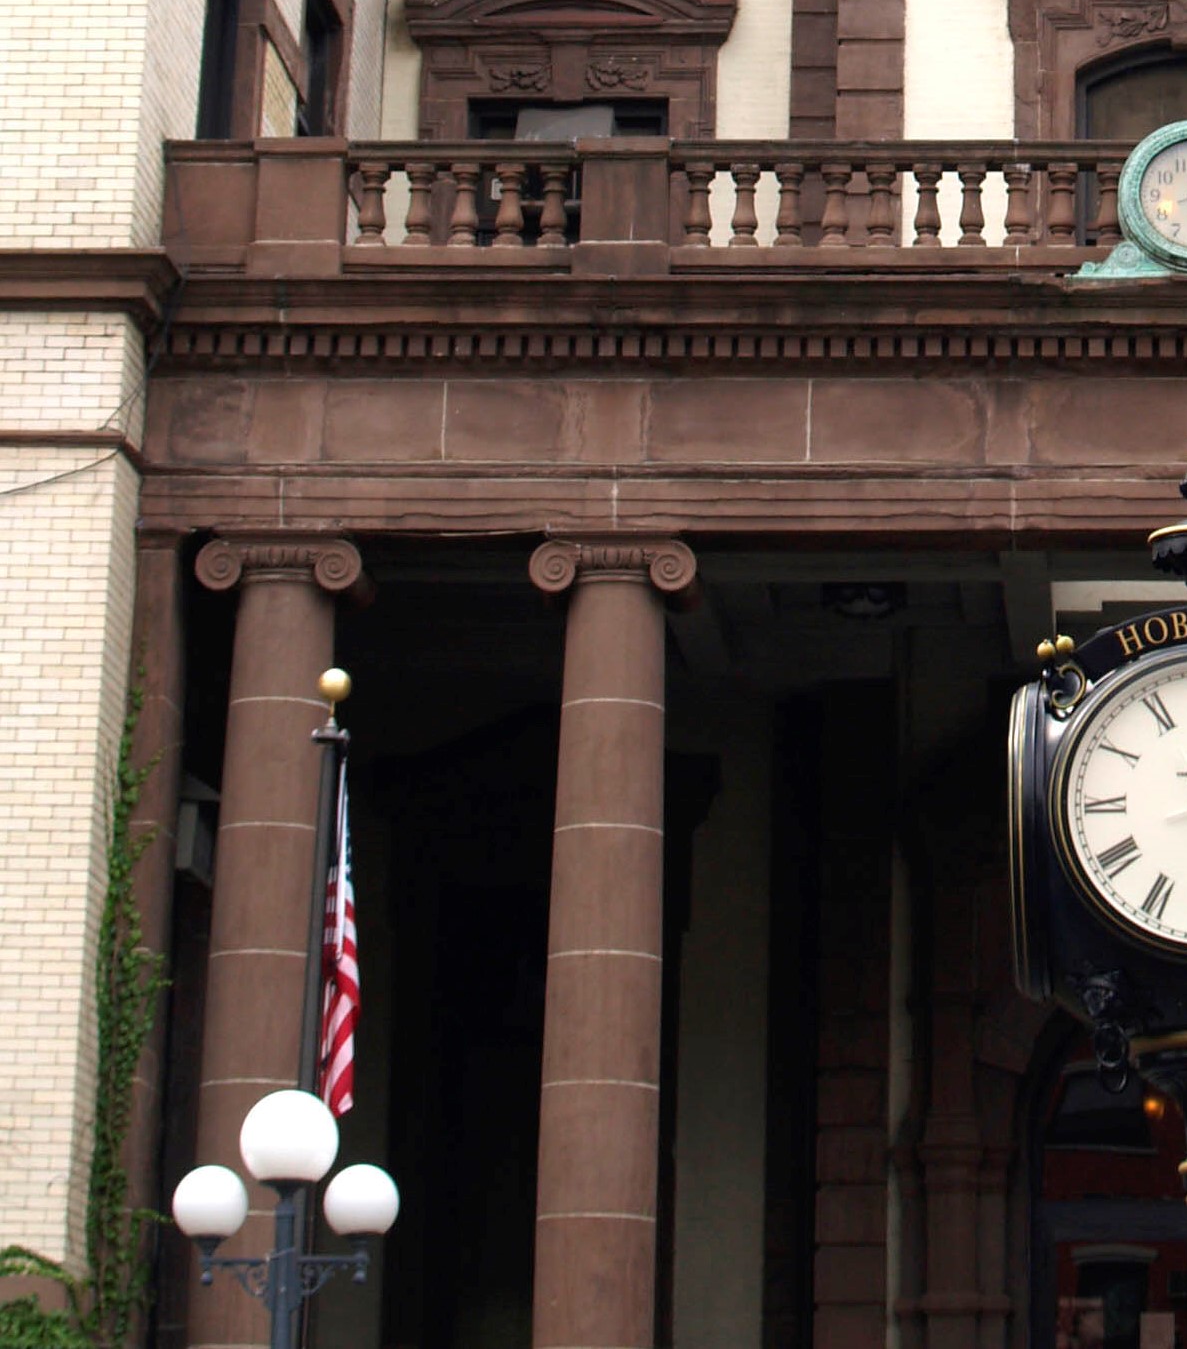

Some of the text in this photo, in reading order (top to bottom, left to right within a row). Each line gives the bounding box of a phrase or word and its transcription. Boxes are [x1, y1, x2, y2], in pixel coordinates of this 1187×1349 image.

[1176, 159, 1187, 173] 11
[1158, 171, 1173, 184] 10
[1151, 189, 1160, 202] 9
[1157, 209, 1167, 221] 8
[1171, 223, 1181, 238] 7
[1141, 691, 1177, 737] XI
[1099, 736, 1142, 769] X
